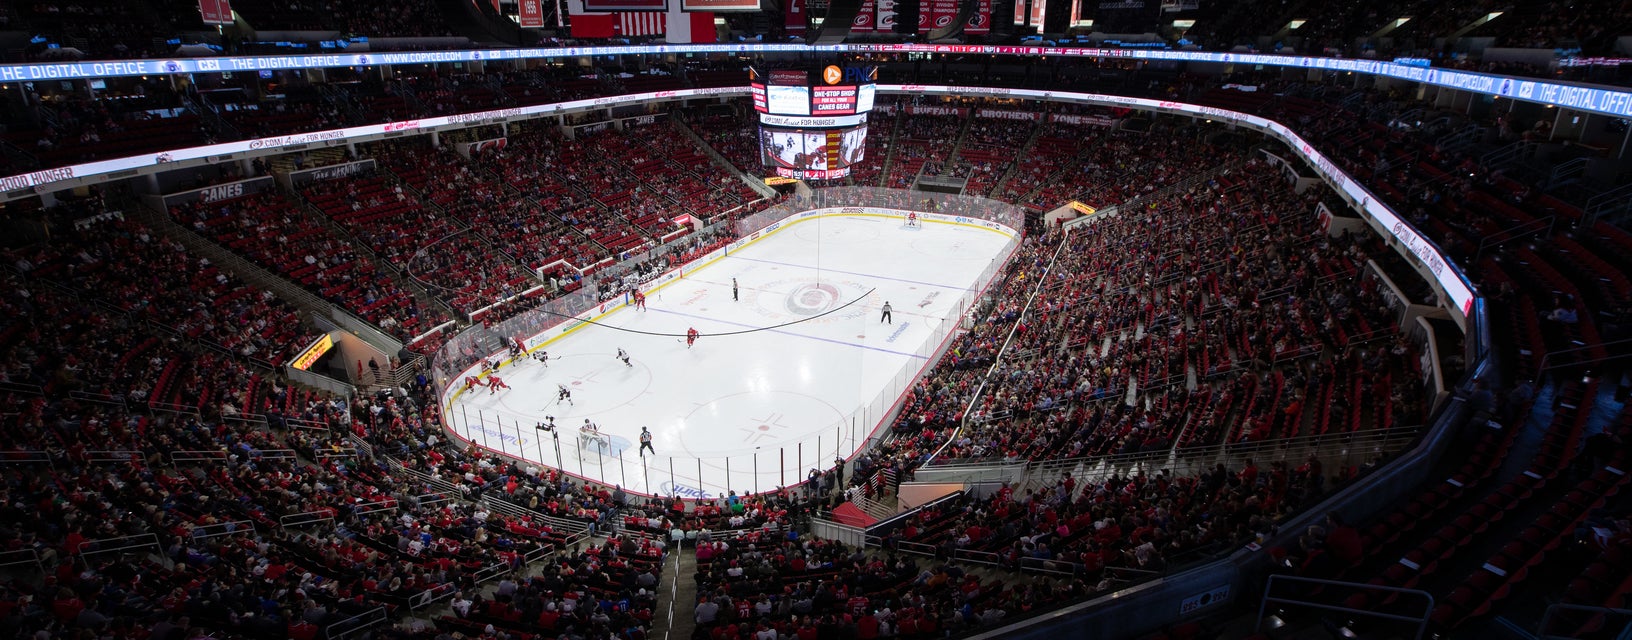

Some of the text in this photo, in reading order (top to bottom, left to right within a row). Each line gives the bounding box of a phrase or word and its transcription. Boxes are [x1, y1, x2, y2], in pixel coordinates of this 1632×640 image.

[506, 48, 564, 58] THE DIGITAL OFFICE
[608, 46, 627, 54] DIGITAL
[629, 45, 649, 53] OFFICE
[1165, 51, 1188, 60] DIGITAL
[1191, 52, 1212, 61] OFFICE
[30, 64, 89, 79] DIGITAL
[94, 61, 147, 76] OFFICE
[231, 56, 340, 70] THE DIGITAL OFFICE
[1540, 83, 1557, 103] THE
[1559, 86, 1597, 110] DIGITAL
[447, 115, 462, 125] HELP
[502, 108, 522, 118] HUNGER
[800, 118, 812, 126] FOR
[812, 118, 836, 126] HUNGER
[913, 106, 958, 115] BUFFALO
[981, 109, 1034, 120] BROTHERS
[1053, 114, 1081, 125] ZONE
[306, 133, 319, 142] FOR
[320, 130, 345, 141] HUNGER
[31, 167, 74, 187] HUNGER
[201, 183, 243, 202] CANES
[765, 223, 780, 234] GEICO
